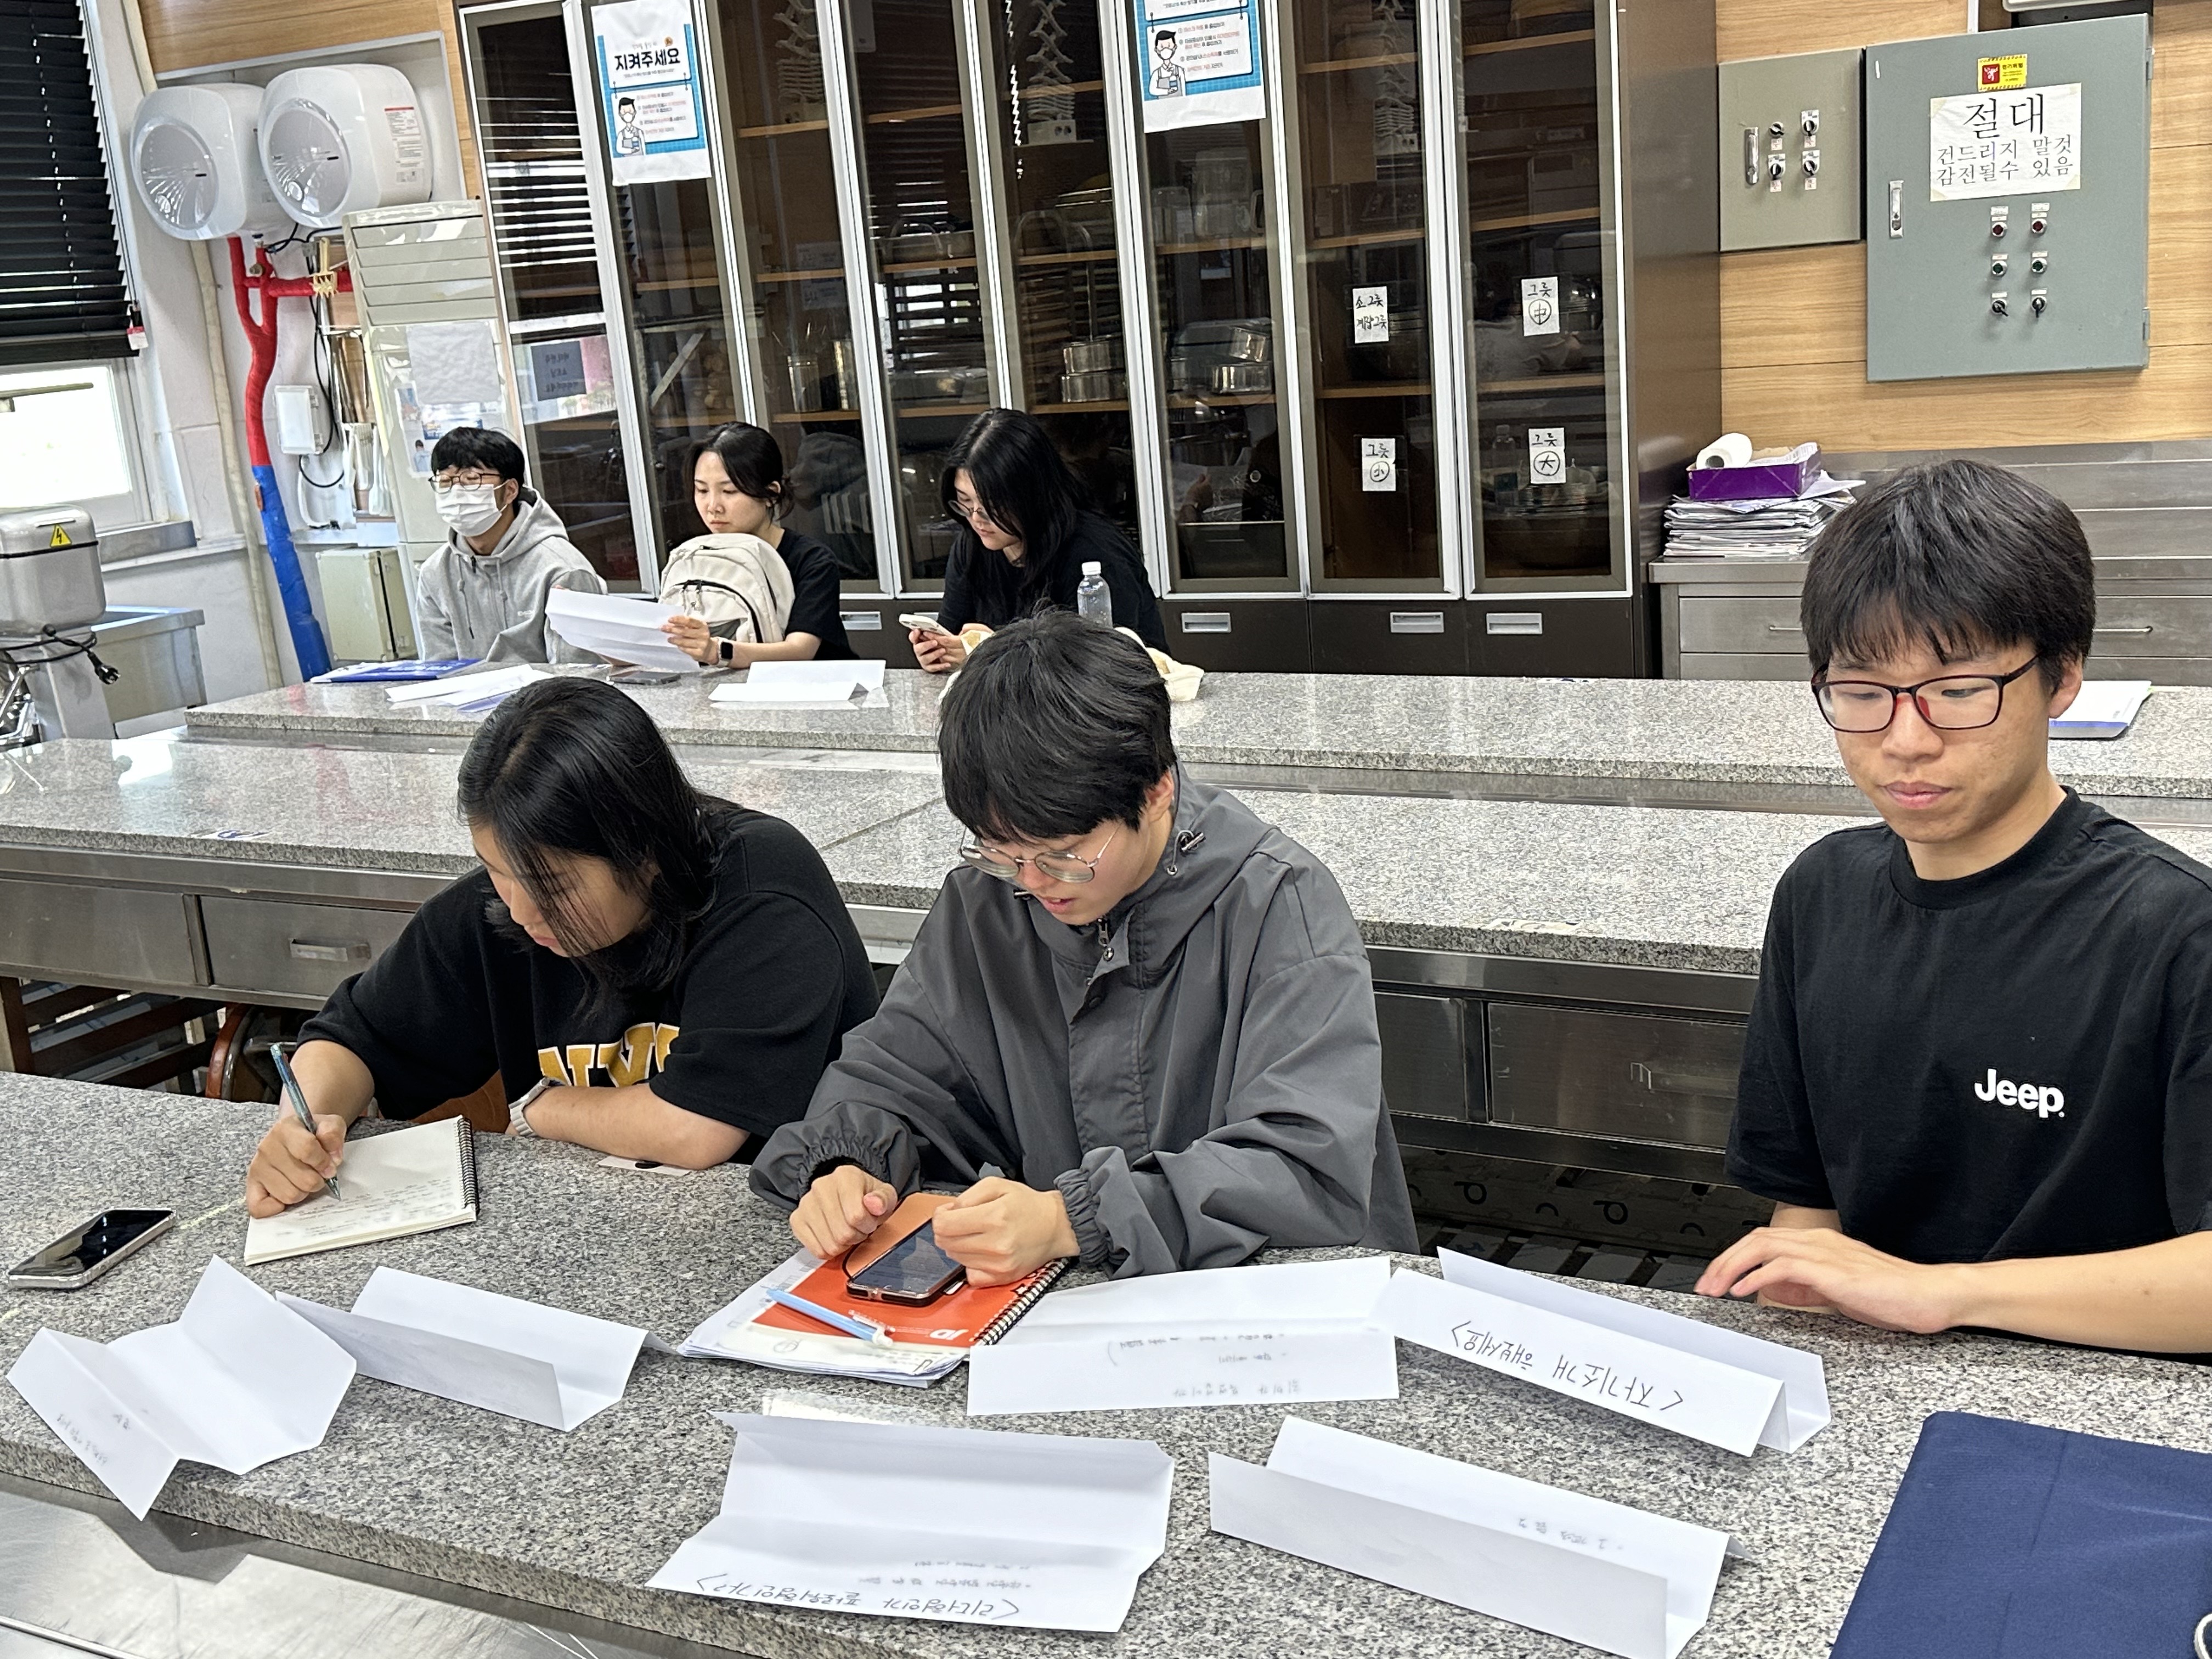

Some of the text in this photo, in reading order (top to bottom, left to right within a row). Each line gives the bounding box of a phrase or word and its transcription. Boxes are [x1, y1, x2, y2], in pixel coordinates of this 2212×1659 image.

[614, 48, 680, 71] 지켜주세요
[1937, 134, 2072, 165] 건드리지 말것
[1937, 156, 2073, 187] 감전될수 있음
[1527, 281, 1552, 297] 그릇
[1531, 432, 1558, 446] 그릇
[1365, 443, 1390, 458] 그릇
